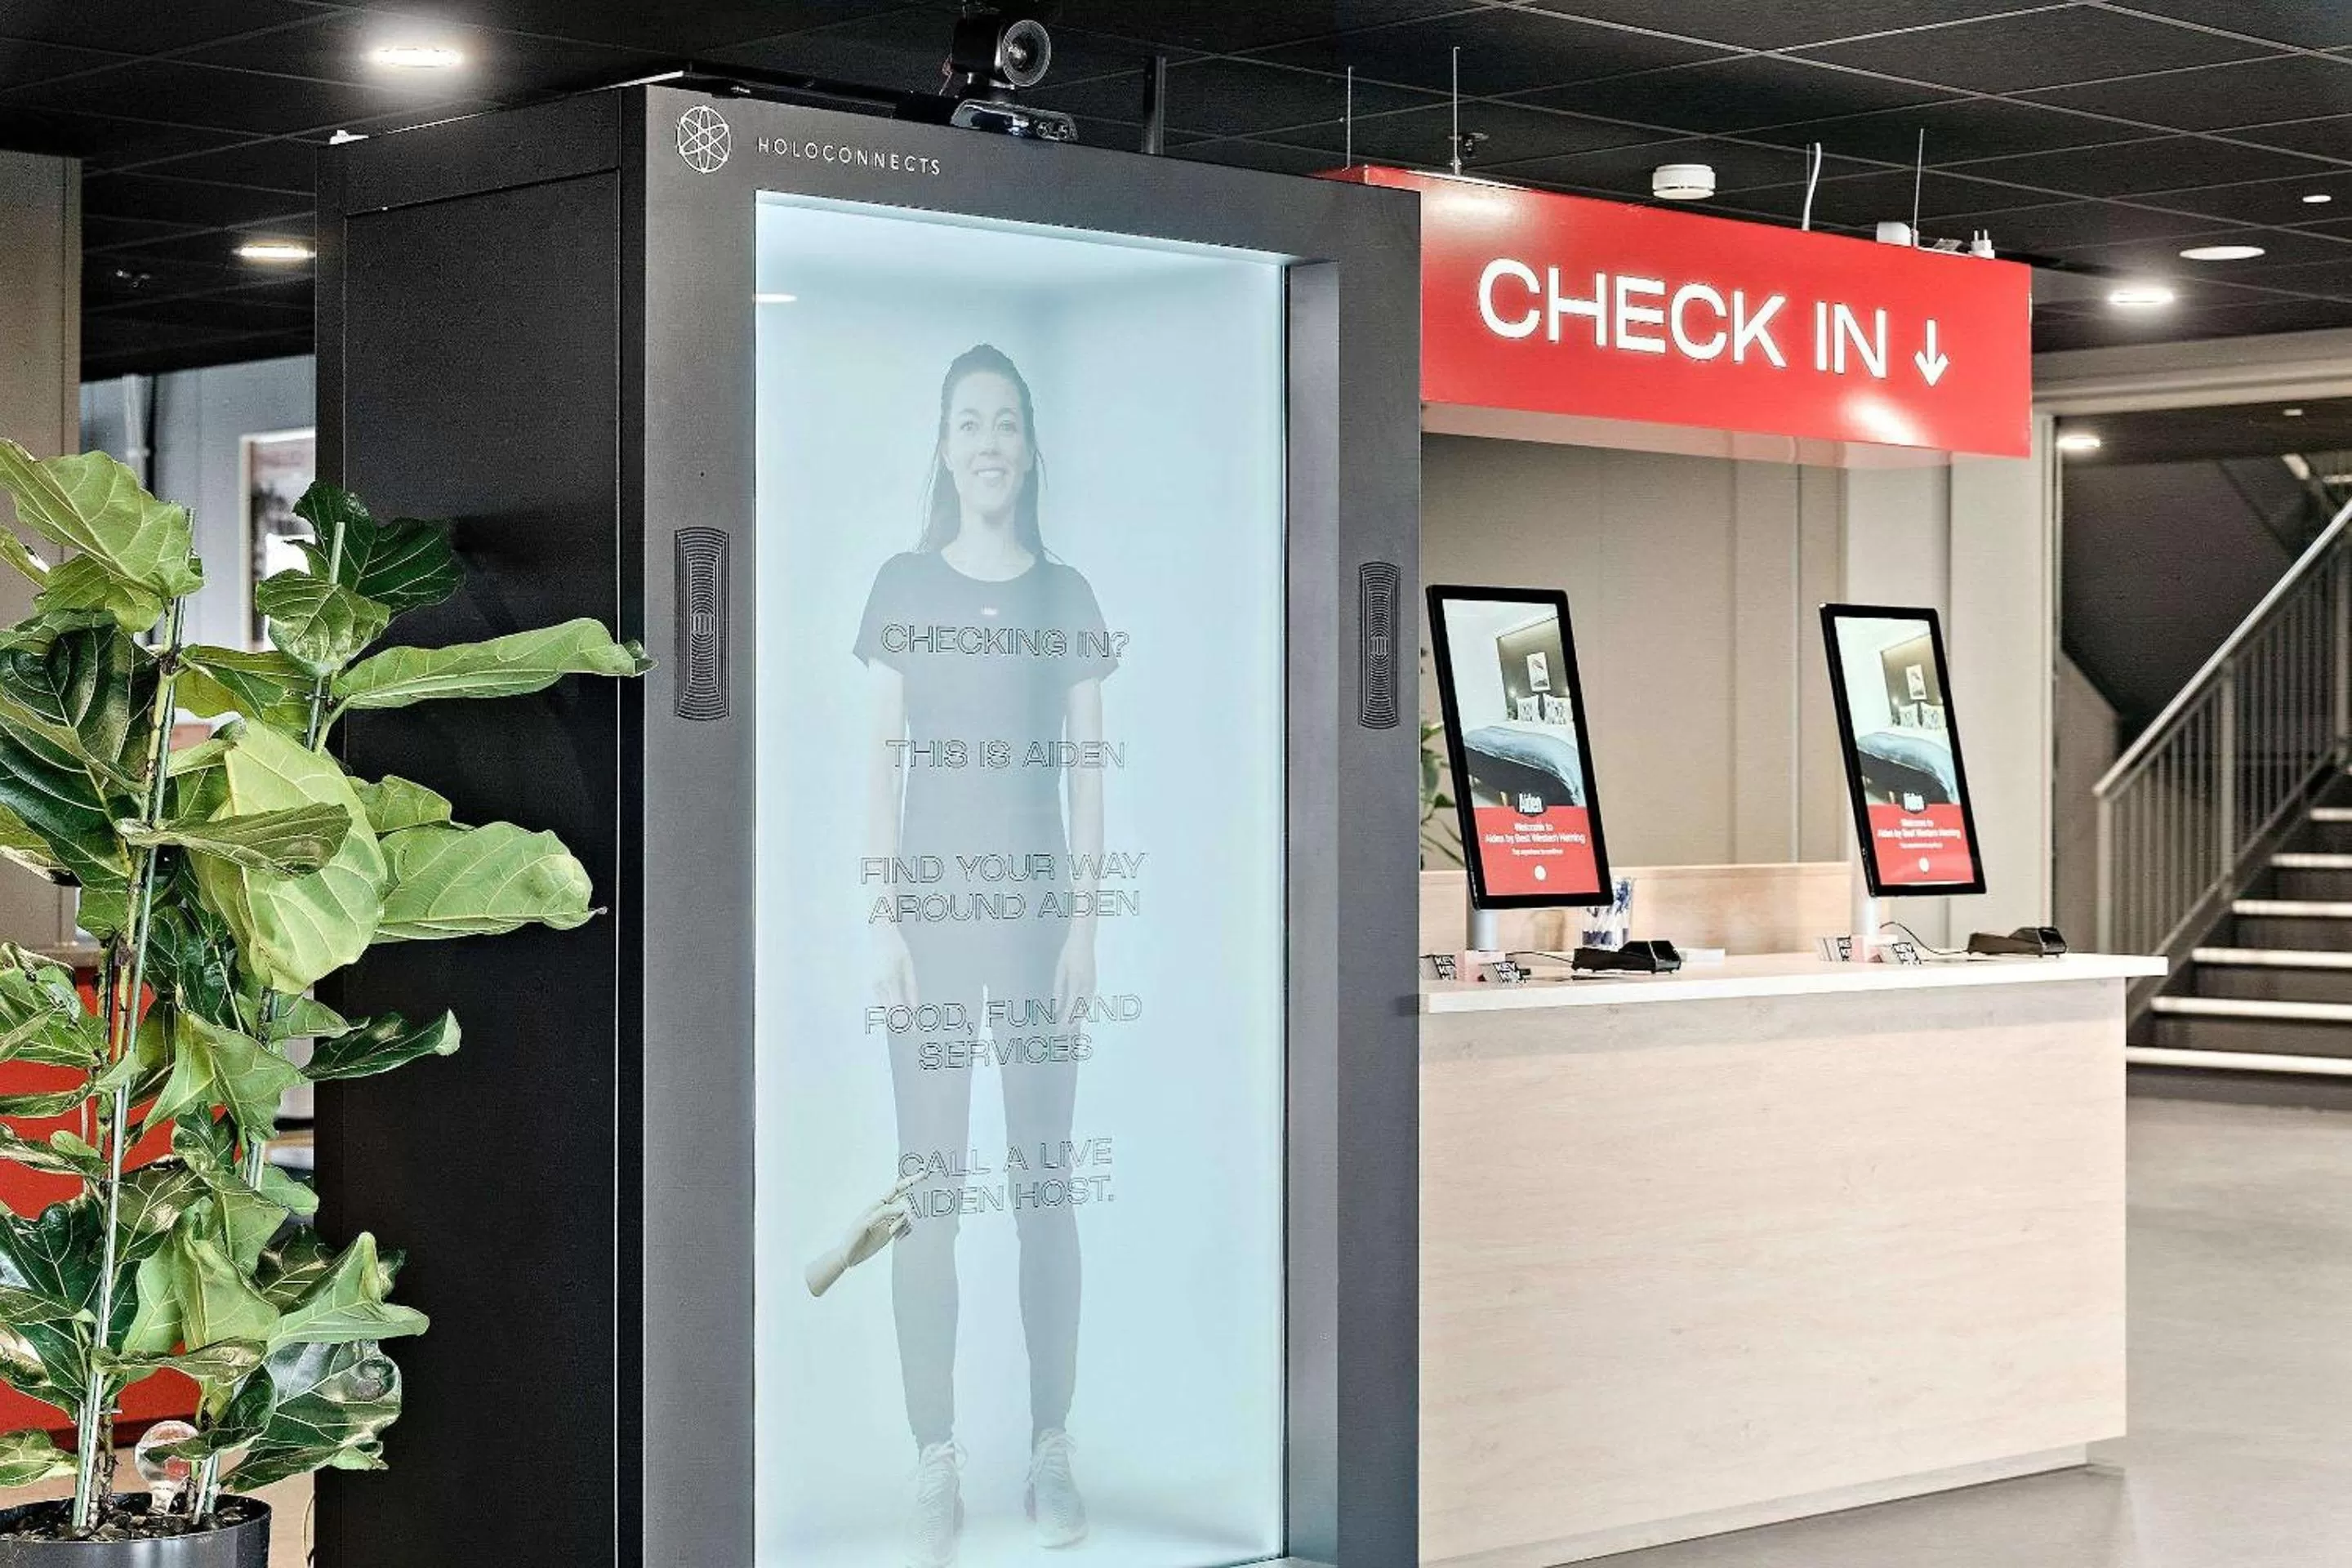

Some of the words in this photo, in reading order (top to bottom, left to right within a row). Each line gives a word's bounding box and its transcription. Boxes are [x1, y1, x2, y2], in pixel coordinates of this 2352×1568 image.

[756, 136, 942, 176] HOLOCONNECTS
[1477, 257, 1788, 369] CHECK
[1814, 300, 1887, 379] IN
[880, 623, 1067, 657] CHECKING
[1076, 630, 1130, 658] IN?
[885, 740, 969, 769] THIS
[979, 740, 1012, 769] IS
[1022, 740, 1126, 769] AIDEN
[859, 854, 945, 885] FIND
[956, 853, 1056, 882] YOUR
[1067, 852, 1150, 880] WAY
[868, 892, 1026, 924] AROUND
[1038, 889, 1140, 919] AIDEN
[865, 1002, 974, 1036] FOOD,
[985, 997, 1058, 1029] FUN
[1068, 992, 1143, 1024] AND
[918, 1035, 1094, 1071] SERVICES
[898, 1147, 991, 1180] CALL
[1003, 1144, 1029, 1172] A
[1040, 1137, 1114, 1170] LIVE
[1015, 1174, 1116, 1210] HOST.
